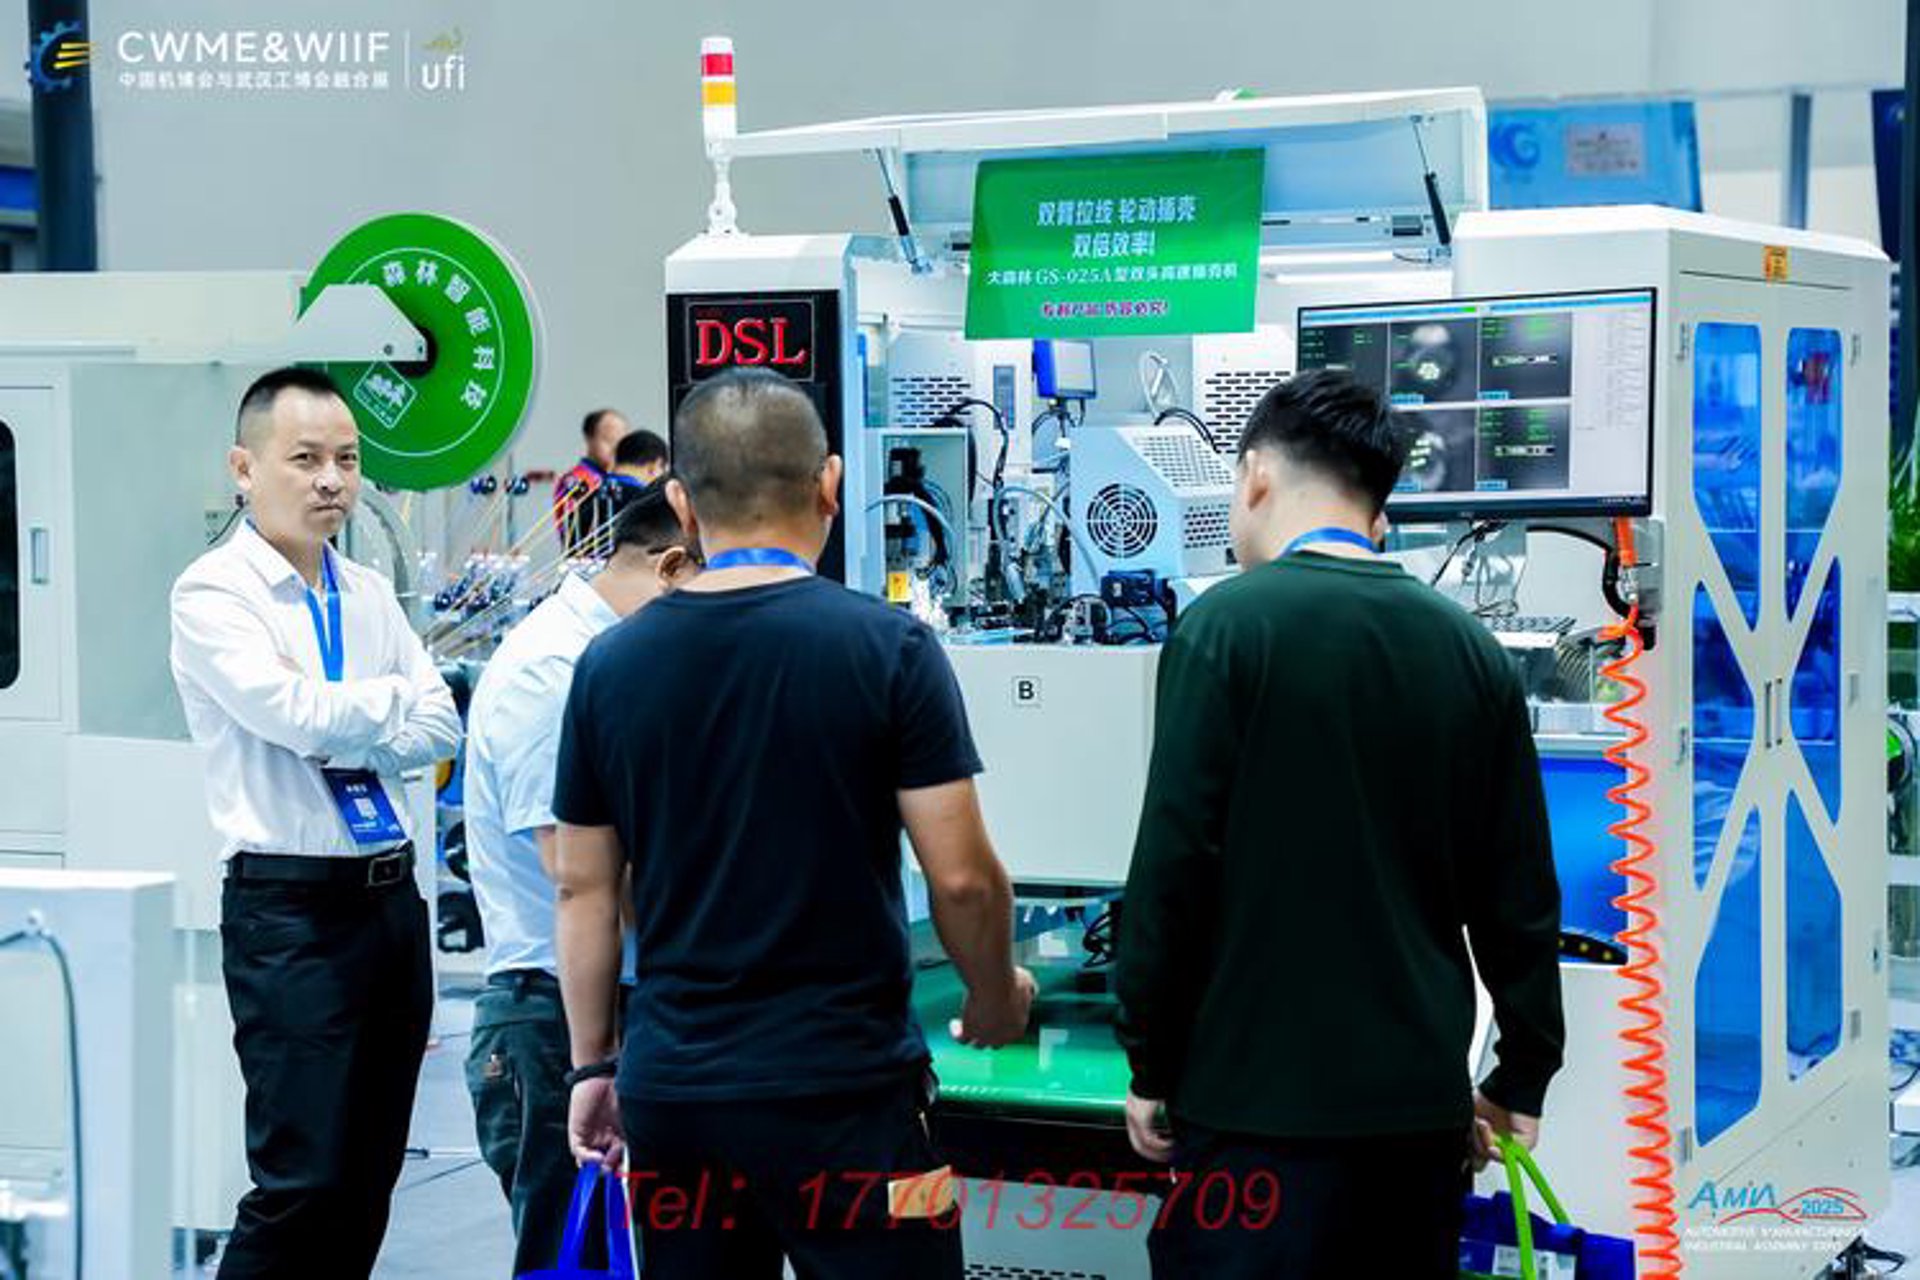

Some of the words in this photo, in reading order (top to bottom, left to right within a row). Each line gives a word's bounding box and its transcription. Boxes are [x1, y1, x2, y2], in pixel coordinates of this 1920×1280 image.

[355, 260, 495, 410] 森林智能科技
[695, 317, 809, 365] DSL
[1018, 680, 1034, 700] B
